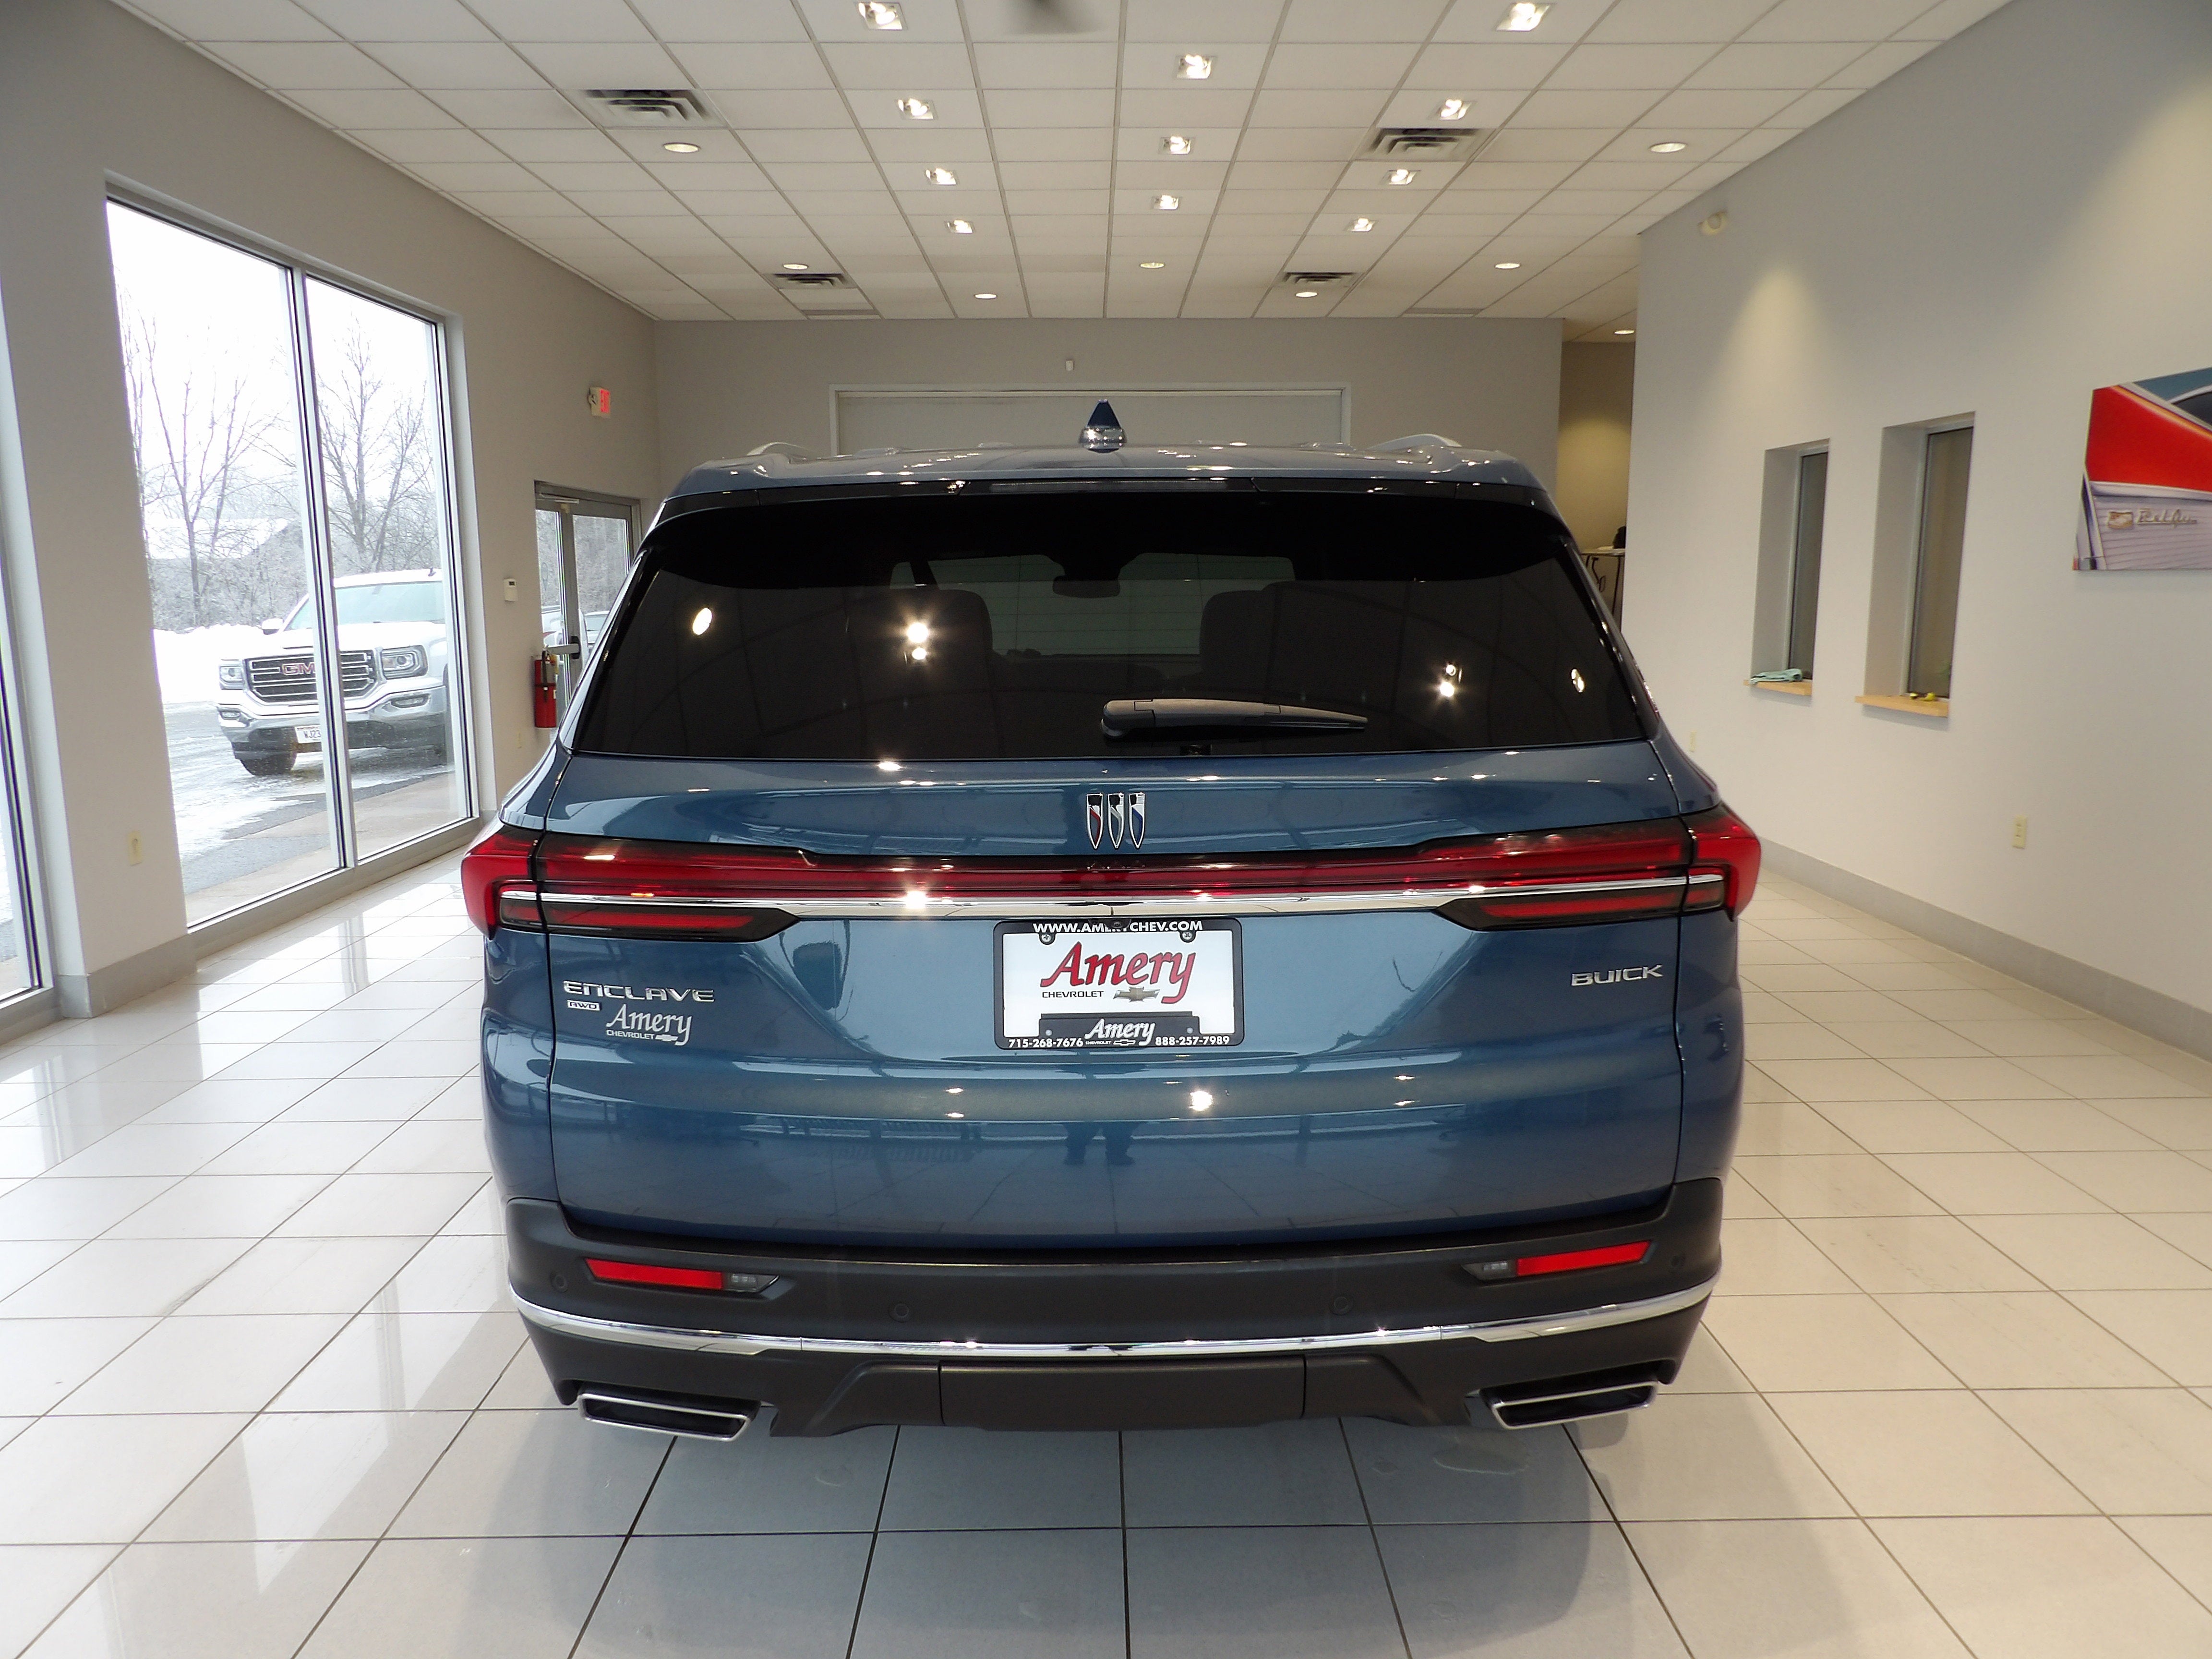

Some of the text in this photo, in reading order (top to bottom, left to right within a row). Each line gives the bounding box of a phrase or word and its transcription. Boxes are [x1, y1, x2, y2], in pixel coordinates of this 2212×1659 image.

[282, 662, 315, 675] GM
[303, 730, 321, 738] WJ23
[1040, 941, 1196, 1004] Amery
[1571, 965, 1663, 986] BUICK
[563, 980, 714, 1002] ENCLAVE
[568, 1001, 599, 1010] AWD
[606, 1003, 692, 1046] Amery
[606, 1030, 655, 1040] CHEVROLET
[1084, 1018, 1155, 1046] Amery
[1009, 1037, 1083, 1048] 715-268-7676
[1155, 1035, 1230, 1046] 888-257-7989
